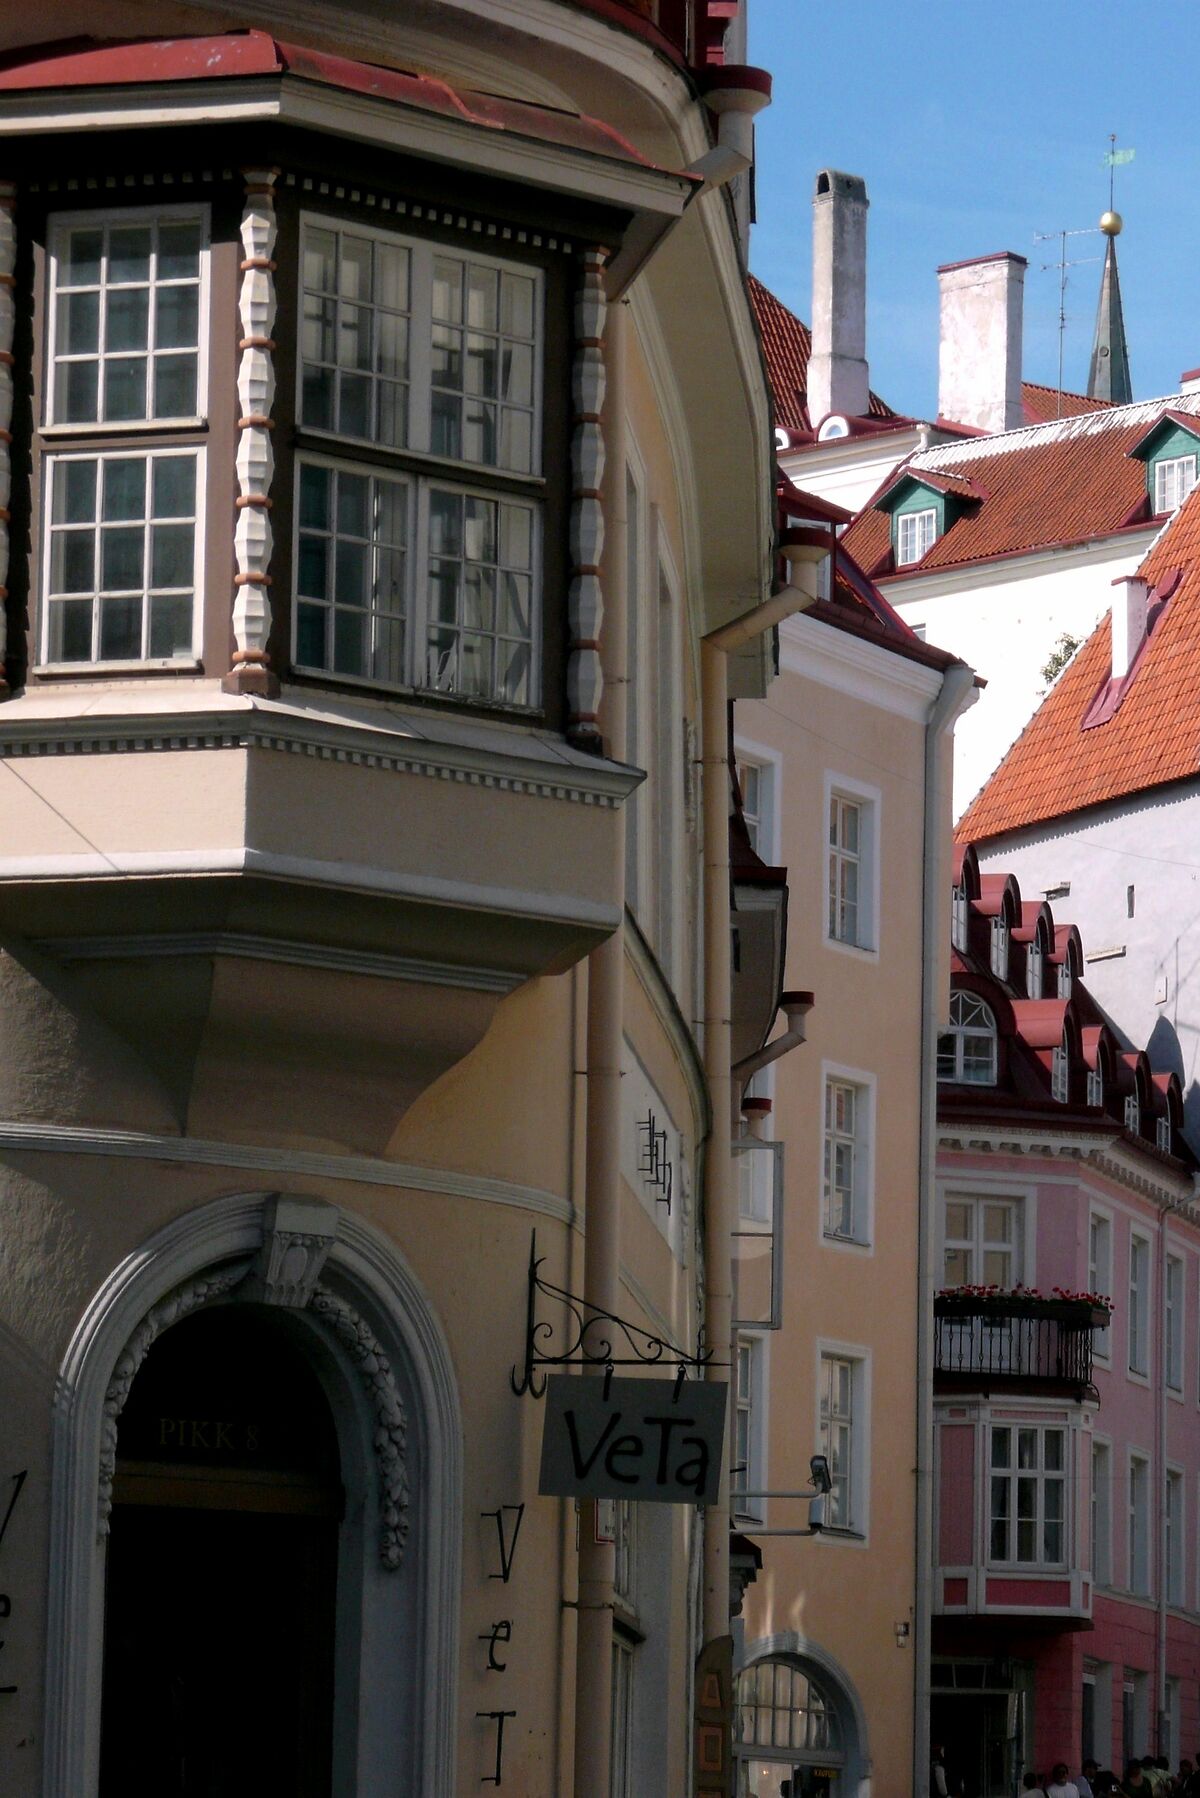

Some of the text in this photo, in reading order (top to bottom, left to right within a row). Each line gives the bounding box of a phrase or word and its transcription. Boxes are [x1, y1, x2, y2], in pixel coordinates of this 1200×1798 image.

[159, 1417, 260, 1451] PIKK 8
[563, 1410, 709, 1496] VeTa
